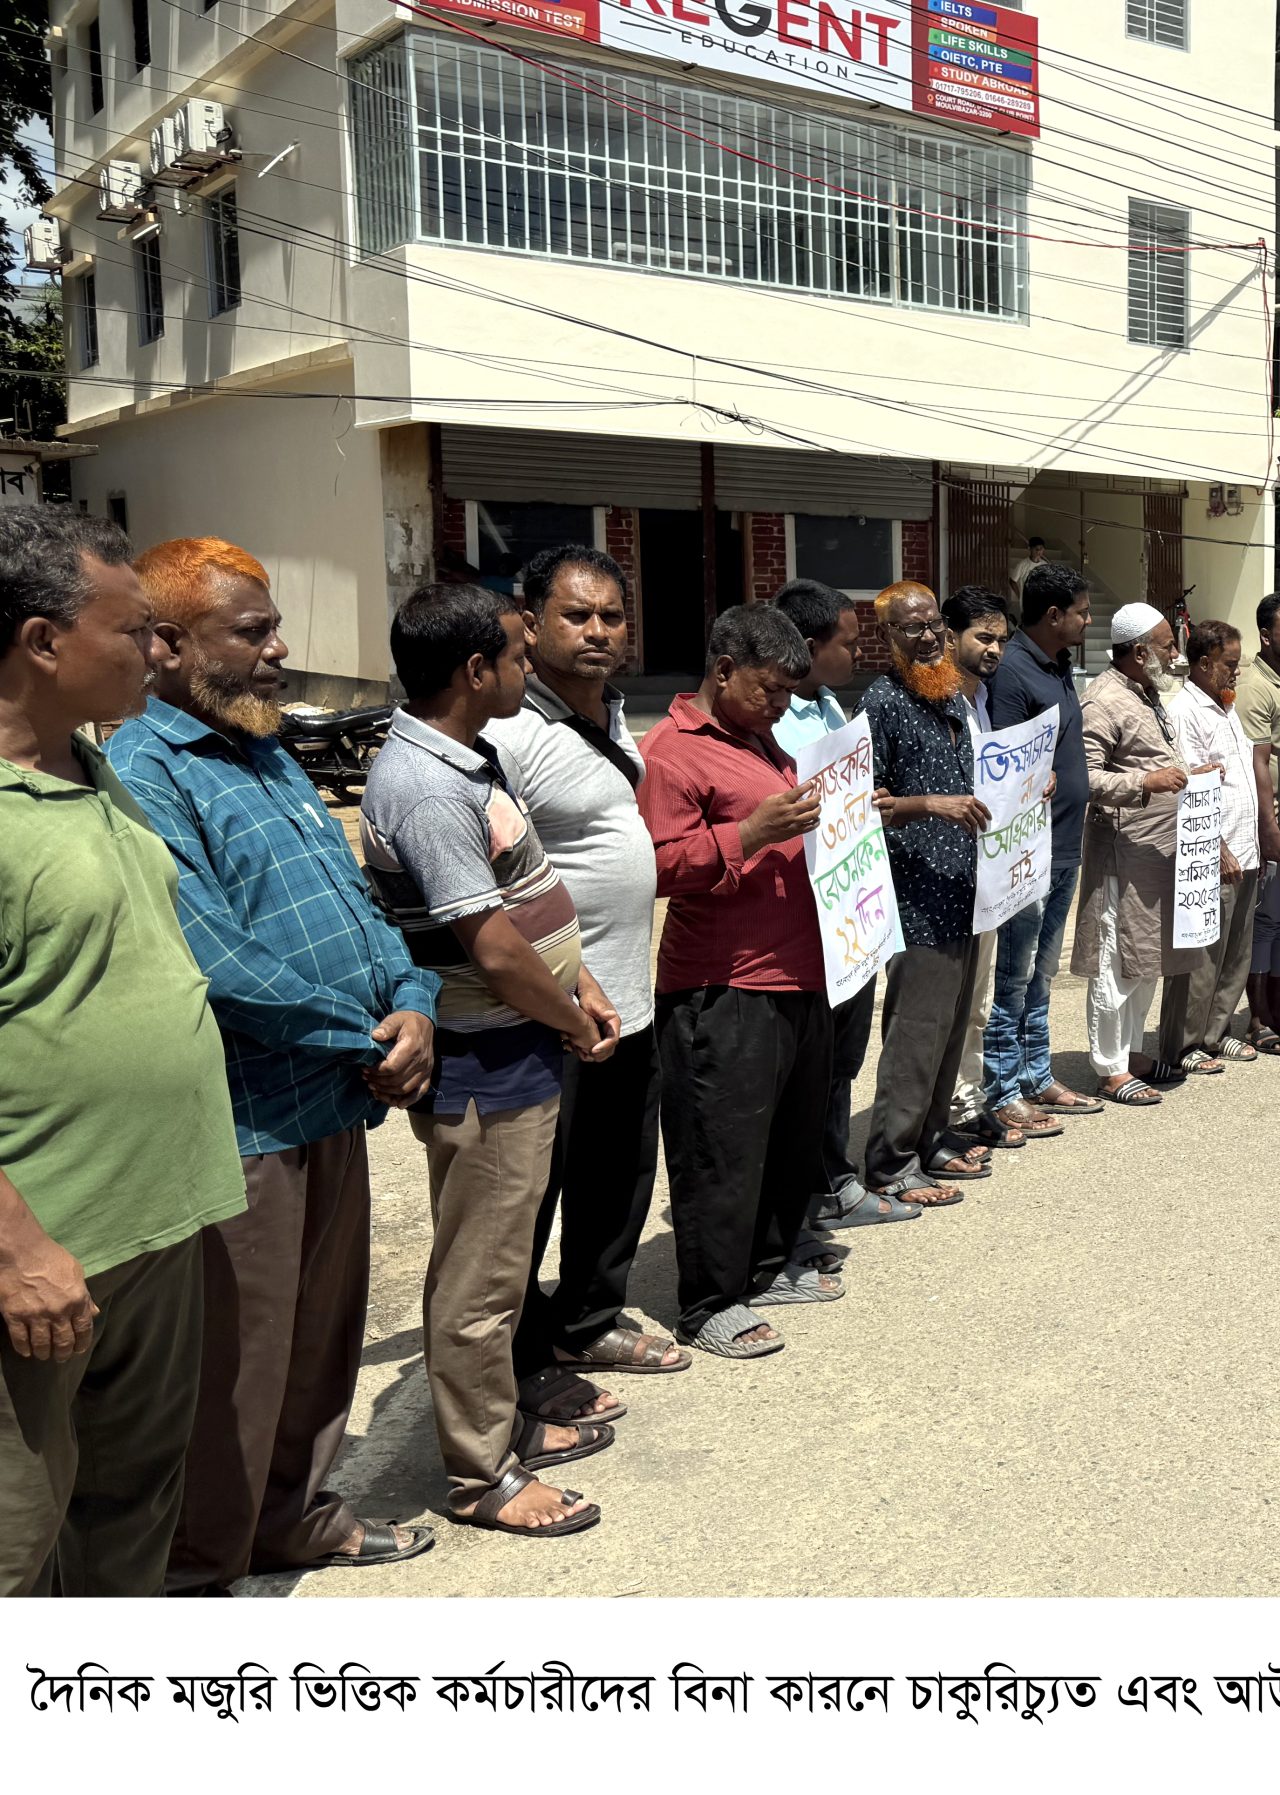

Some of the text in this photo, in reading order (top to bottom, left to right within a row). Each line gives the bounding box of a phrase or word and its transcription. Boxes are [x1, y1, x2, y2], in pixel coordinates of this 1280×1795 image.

[545, 9, 583, 29] TEST
[940, 0, 972, 17] IELTS
[940, 17, 988, 38] SPOKEN
[681, 30, 849, 79] EDUCATION
[940, 33, 1008, 59] LIFE SKILLS
[940, 50, 1003, 74] OIETC, PTE
[941, 67, 979, 84] STUDY
[839, 736, 871, 786] করি
[822, 790, 869, 850] ৩০ দিন
[979, 801, 1047, 859] অধিকার
[1009, 849, 1036, 890] চাই
[855, 884, 884, 936] দিন
